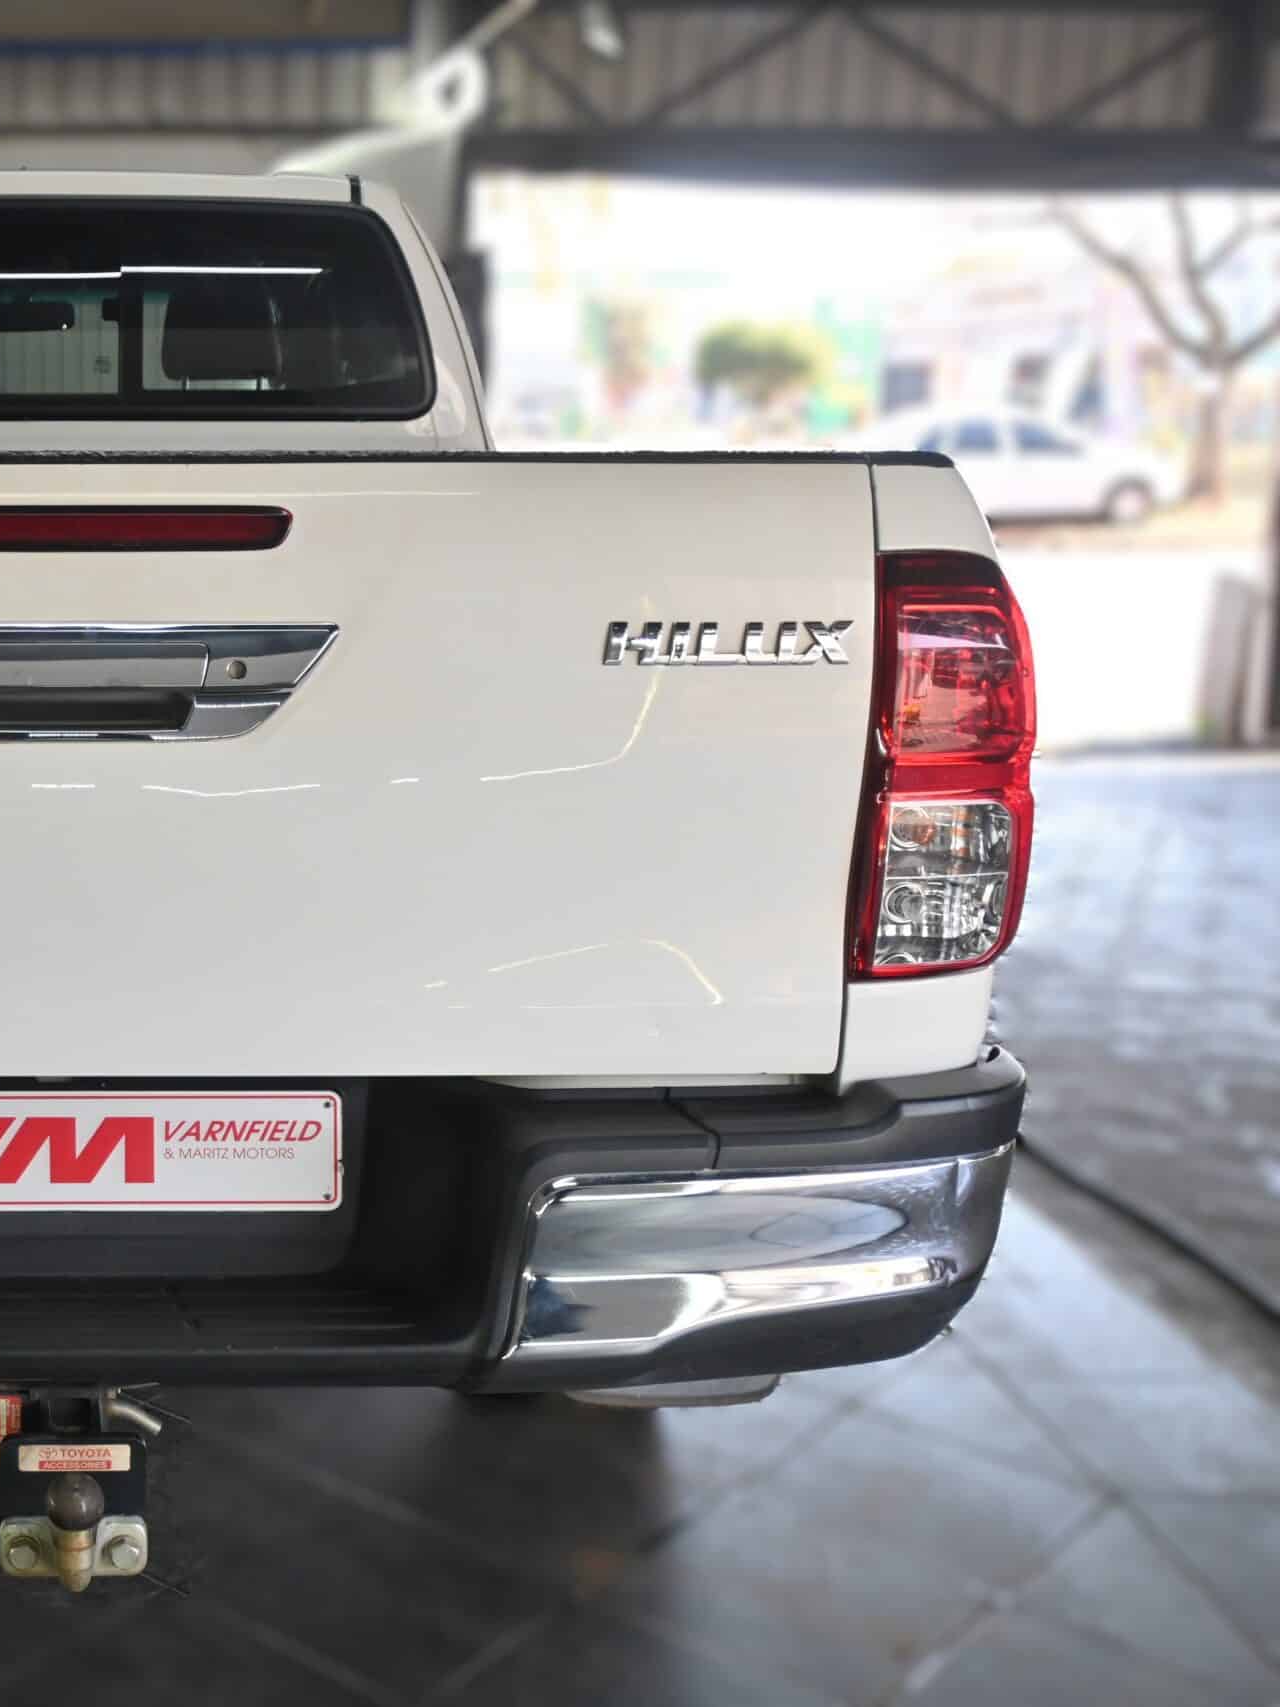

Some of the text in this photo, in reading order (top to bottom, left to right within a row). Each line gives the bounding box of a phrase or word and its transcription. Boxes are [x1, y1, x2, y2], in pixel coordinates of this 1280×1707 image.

[602, 621, 854, 665] HILUX
[164, 1120, 322, 1142] VARNFIELD
[163, 1147, 295, 1160] & MARITZ MOTORS
[60, 1448, 111, 1458] TOYOTA
